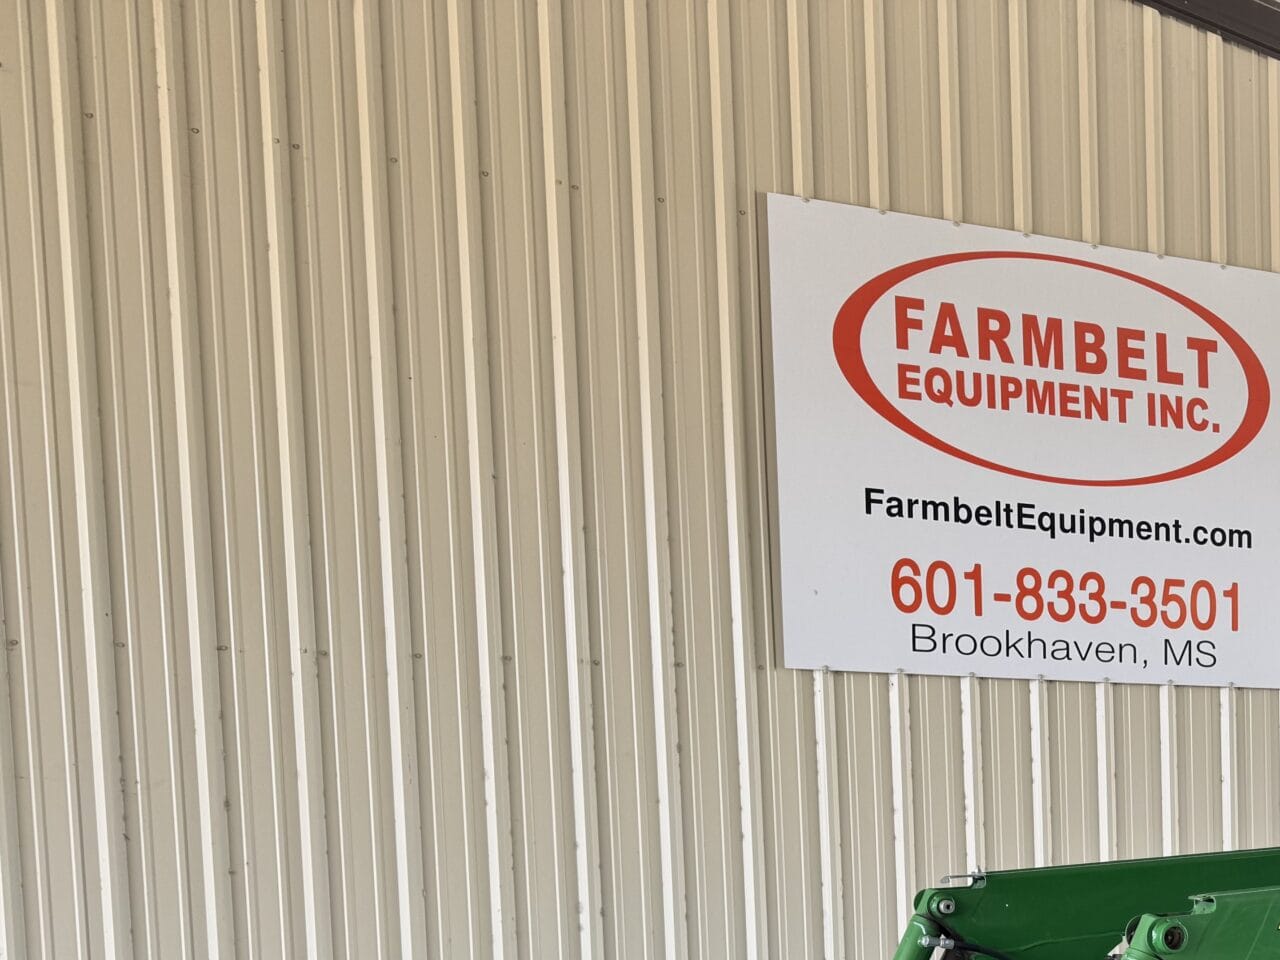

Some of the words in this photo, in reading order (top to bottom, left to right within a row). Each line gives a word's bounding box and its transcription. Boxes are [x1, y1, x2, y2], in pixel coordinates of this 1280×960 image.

[895, 296, 1218, 389] FARMBELT
[897, 363, 1133, 424] EQUIPMENT
[1147, 392, 1220, 433] INC.
[864, 488, 1252, 549] FarmbeltEquipment.com
[890, 558, 1239, 632] 601-833-3501
[911, 623, 1149, 668] Brookhaven,
[1164, 638, 1217, 668] MS
